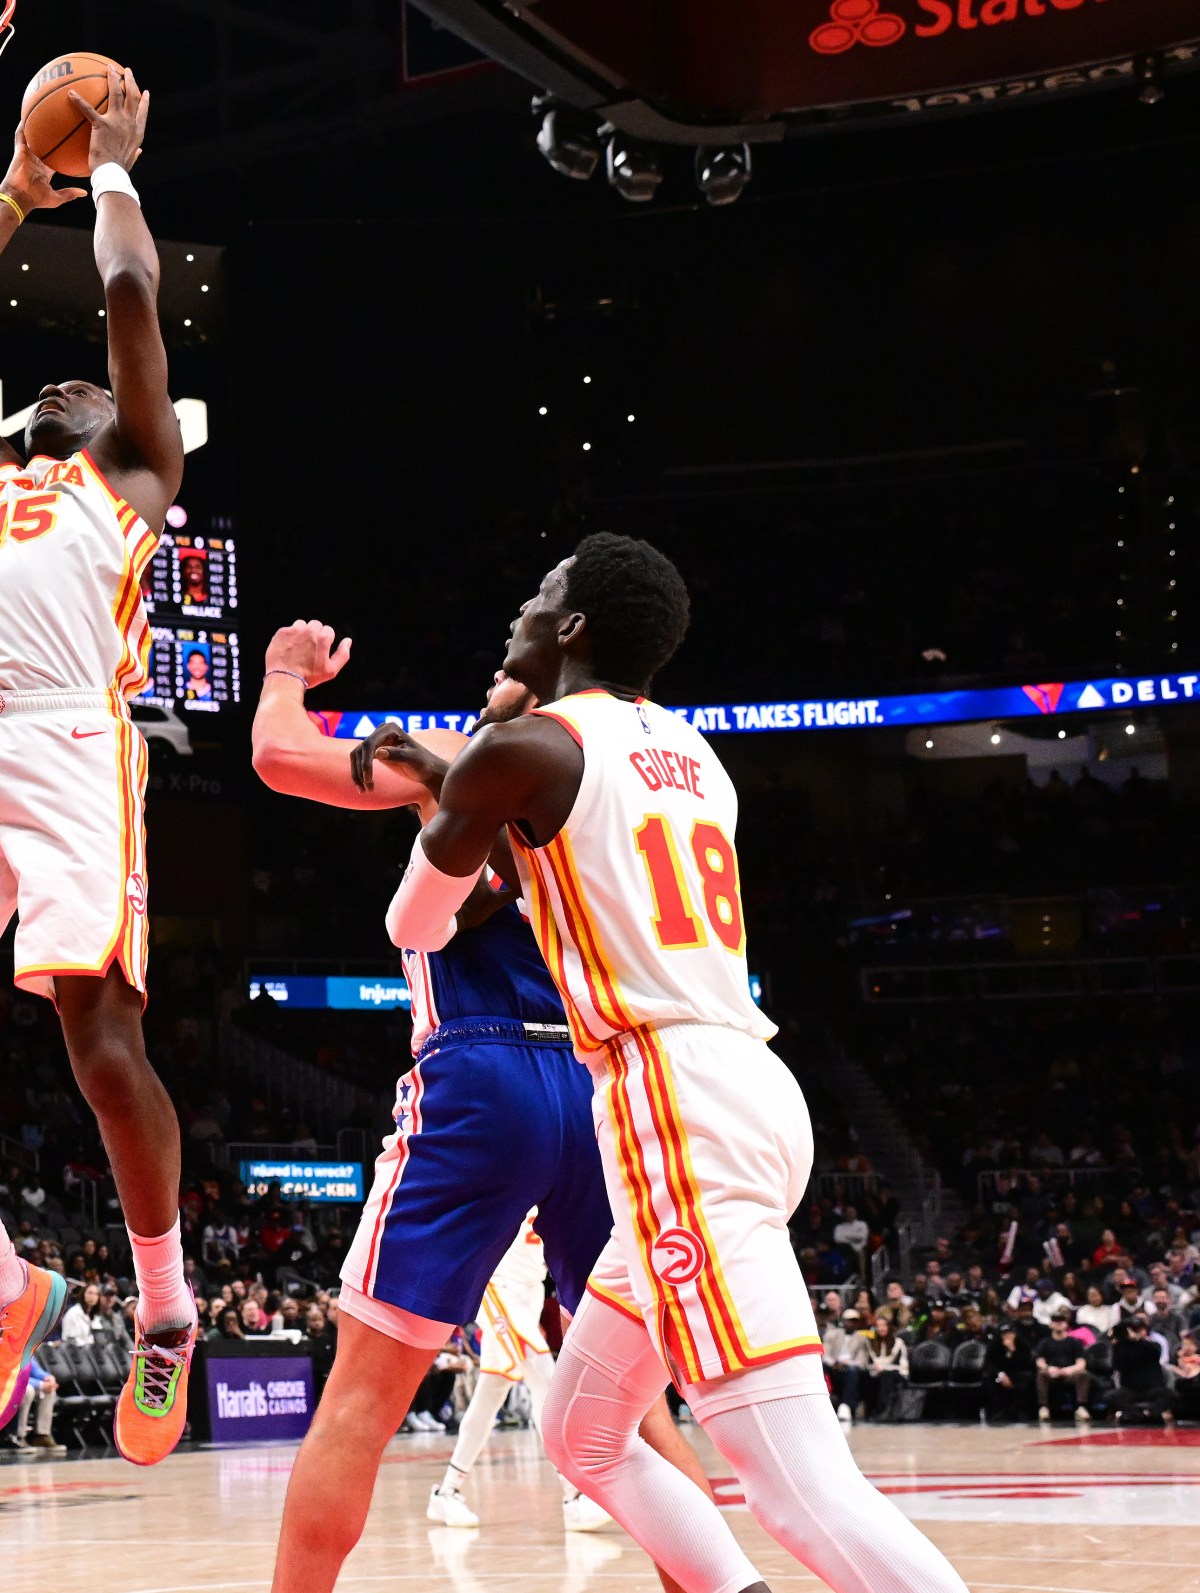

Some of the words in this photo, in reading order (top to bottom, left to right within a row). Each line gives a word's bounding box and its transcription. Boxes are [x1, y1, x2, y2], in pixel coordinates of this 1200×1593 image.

[693, 707, 731, 731] ATL
[732, 703, 801, 730] TAKES
[803, 700, 884, 726] FLIGHT.
[629, 748, 705, 800] GUEYE
[632, 813, 746, 957] 18
[291, 1164, 303, 1177] in
[303, 1167, 313, 1177] a
[268, 1397, 308, 1416] CASINOS
